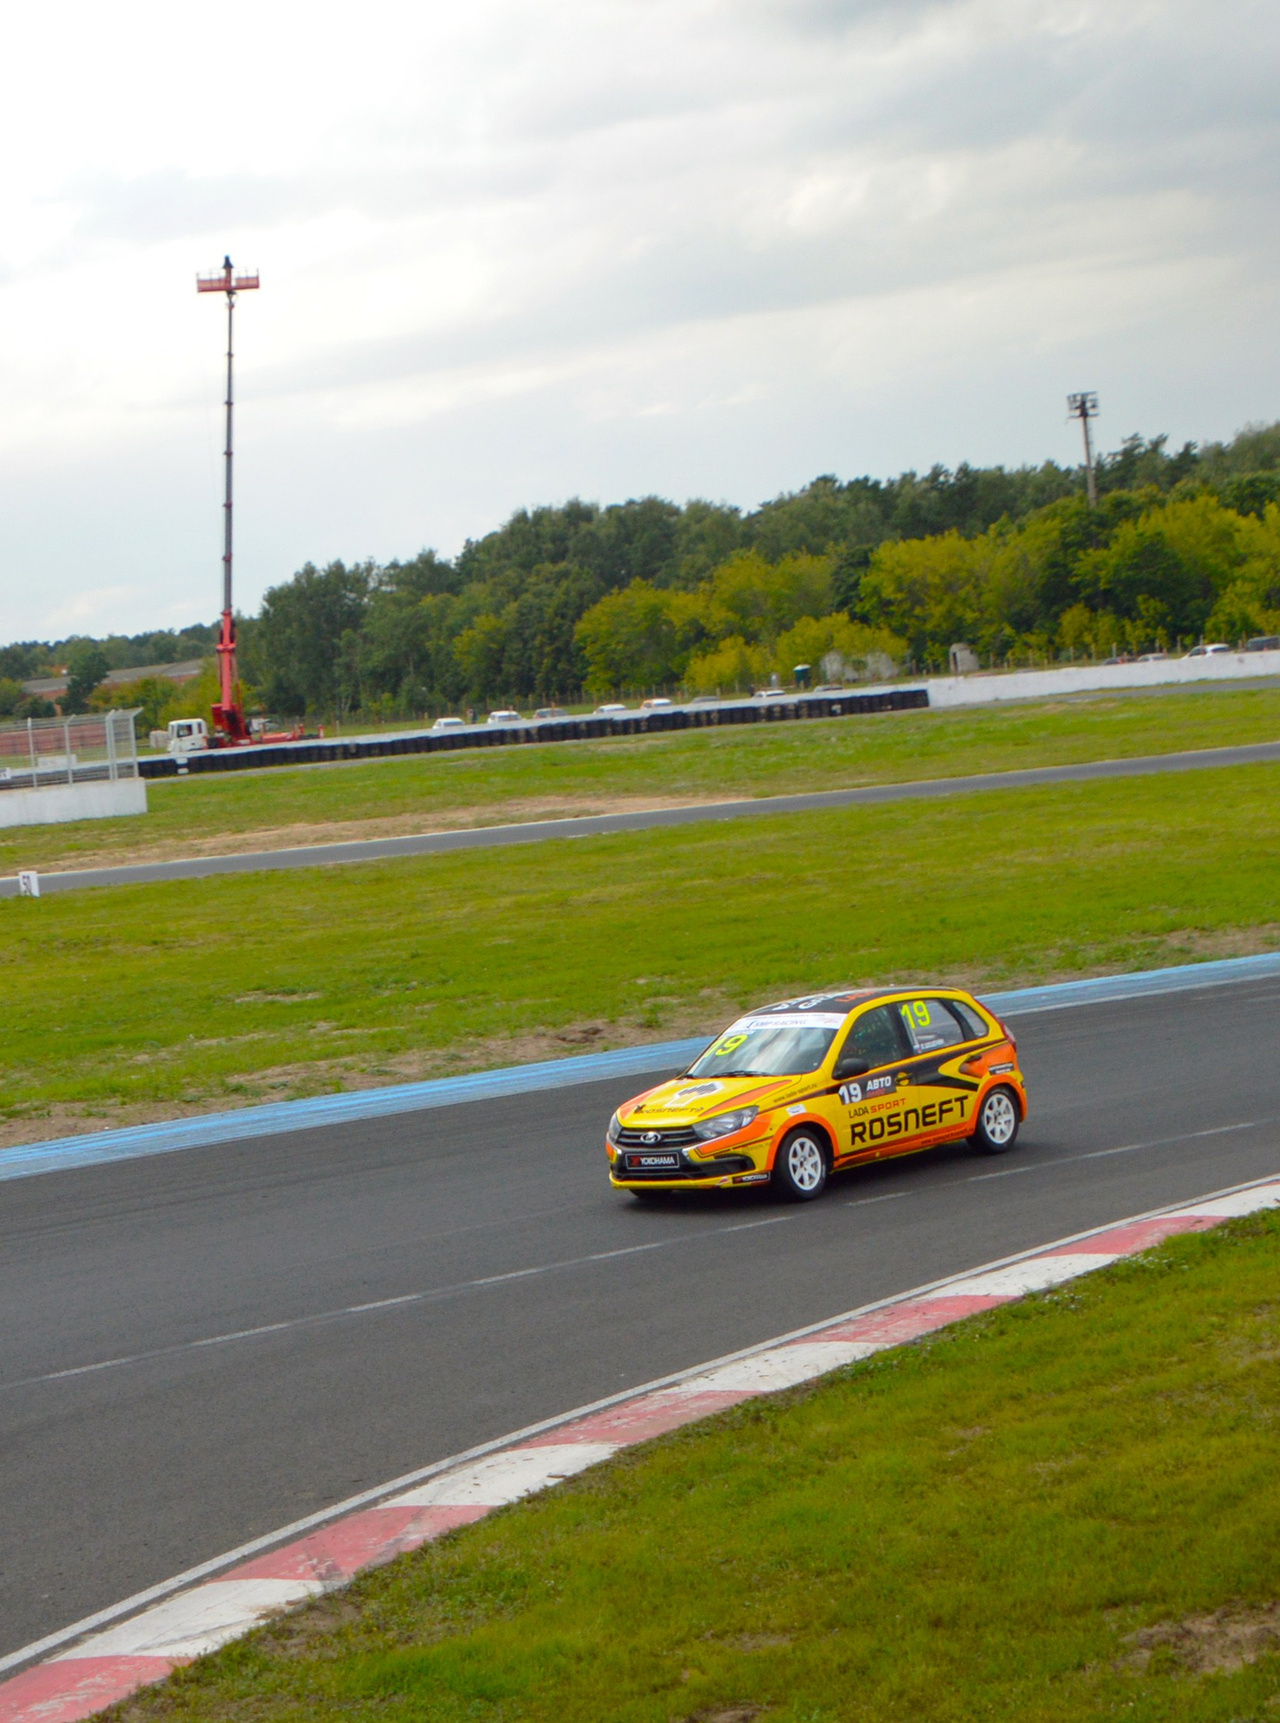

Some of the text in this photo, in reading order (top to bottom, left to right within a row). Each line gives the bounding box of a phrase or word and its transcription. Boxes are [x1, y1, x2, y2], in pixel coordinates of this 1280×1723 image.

[901, 1000, 931, 1028] 19
[704, 1034, 748, 1058] 19
[838, 1083, 862, 1105] 19
[866, 1076, 892, 1091] АВТО
[848, 1098, 906, 1119] LADA SPORT
[850, 1095, 969, 1146] ROSNEFT
[639, 1156, 676, 1166] YOKOHAMA
